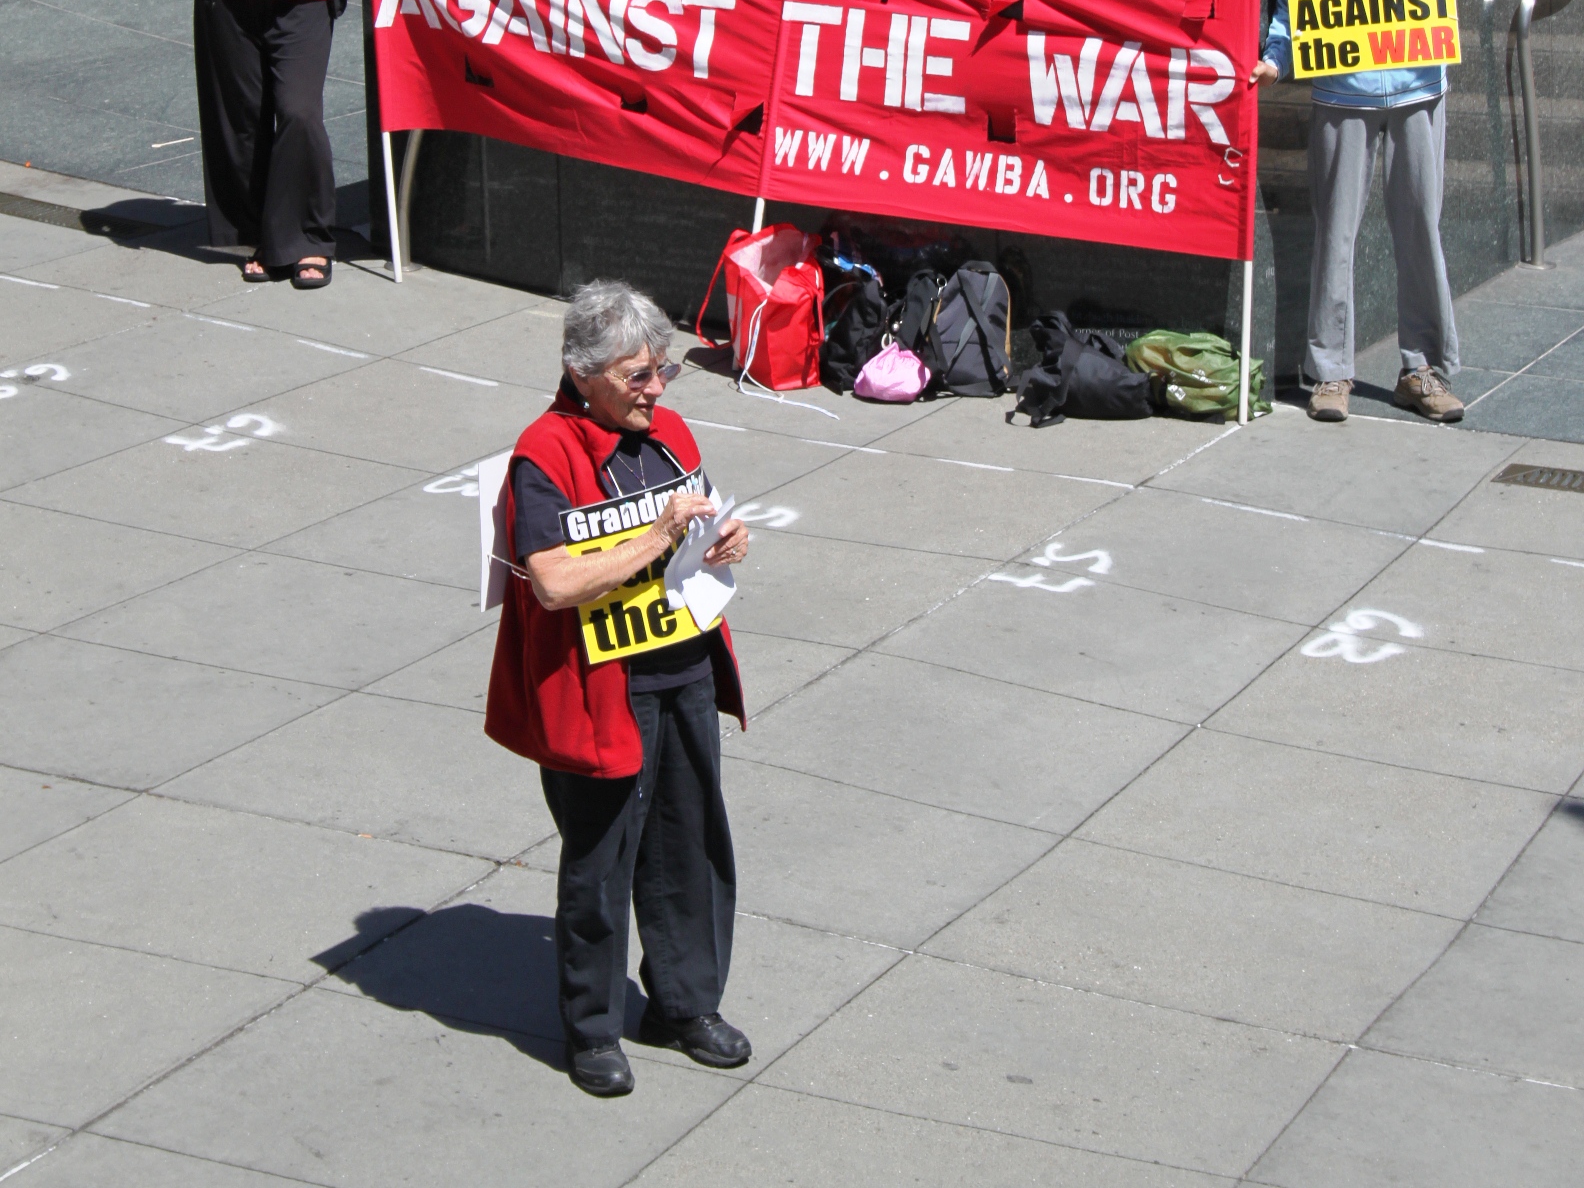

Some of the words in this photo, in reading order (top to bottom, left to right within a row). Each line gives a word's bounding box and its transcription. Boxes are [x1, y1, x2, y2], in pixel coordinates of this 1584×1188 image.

[1298, 38, 1360, 71] the
[1367, 26, 1456, 64] WAR
[783, 1, 970, 113] THE
[1027, 31, 1235, 145] WAR
[1119, 328, 1139, 338] Post
[589, 601, 677, 652] the
